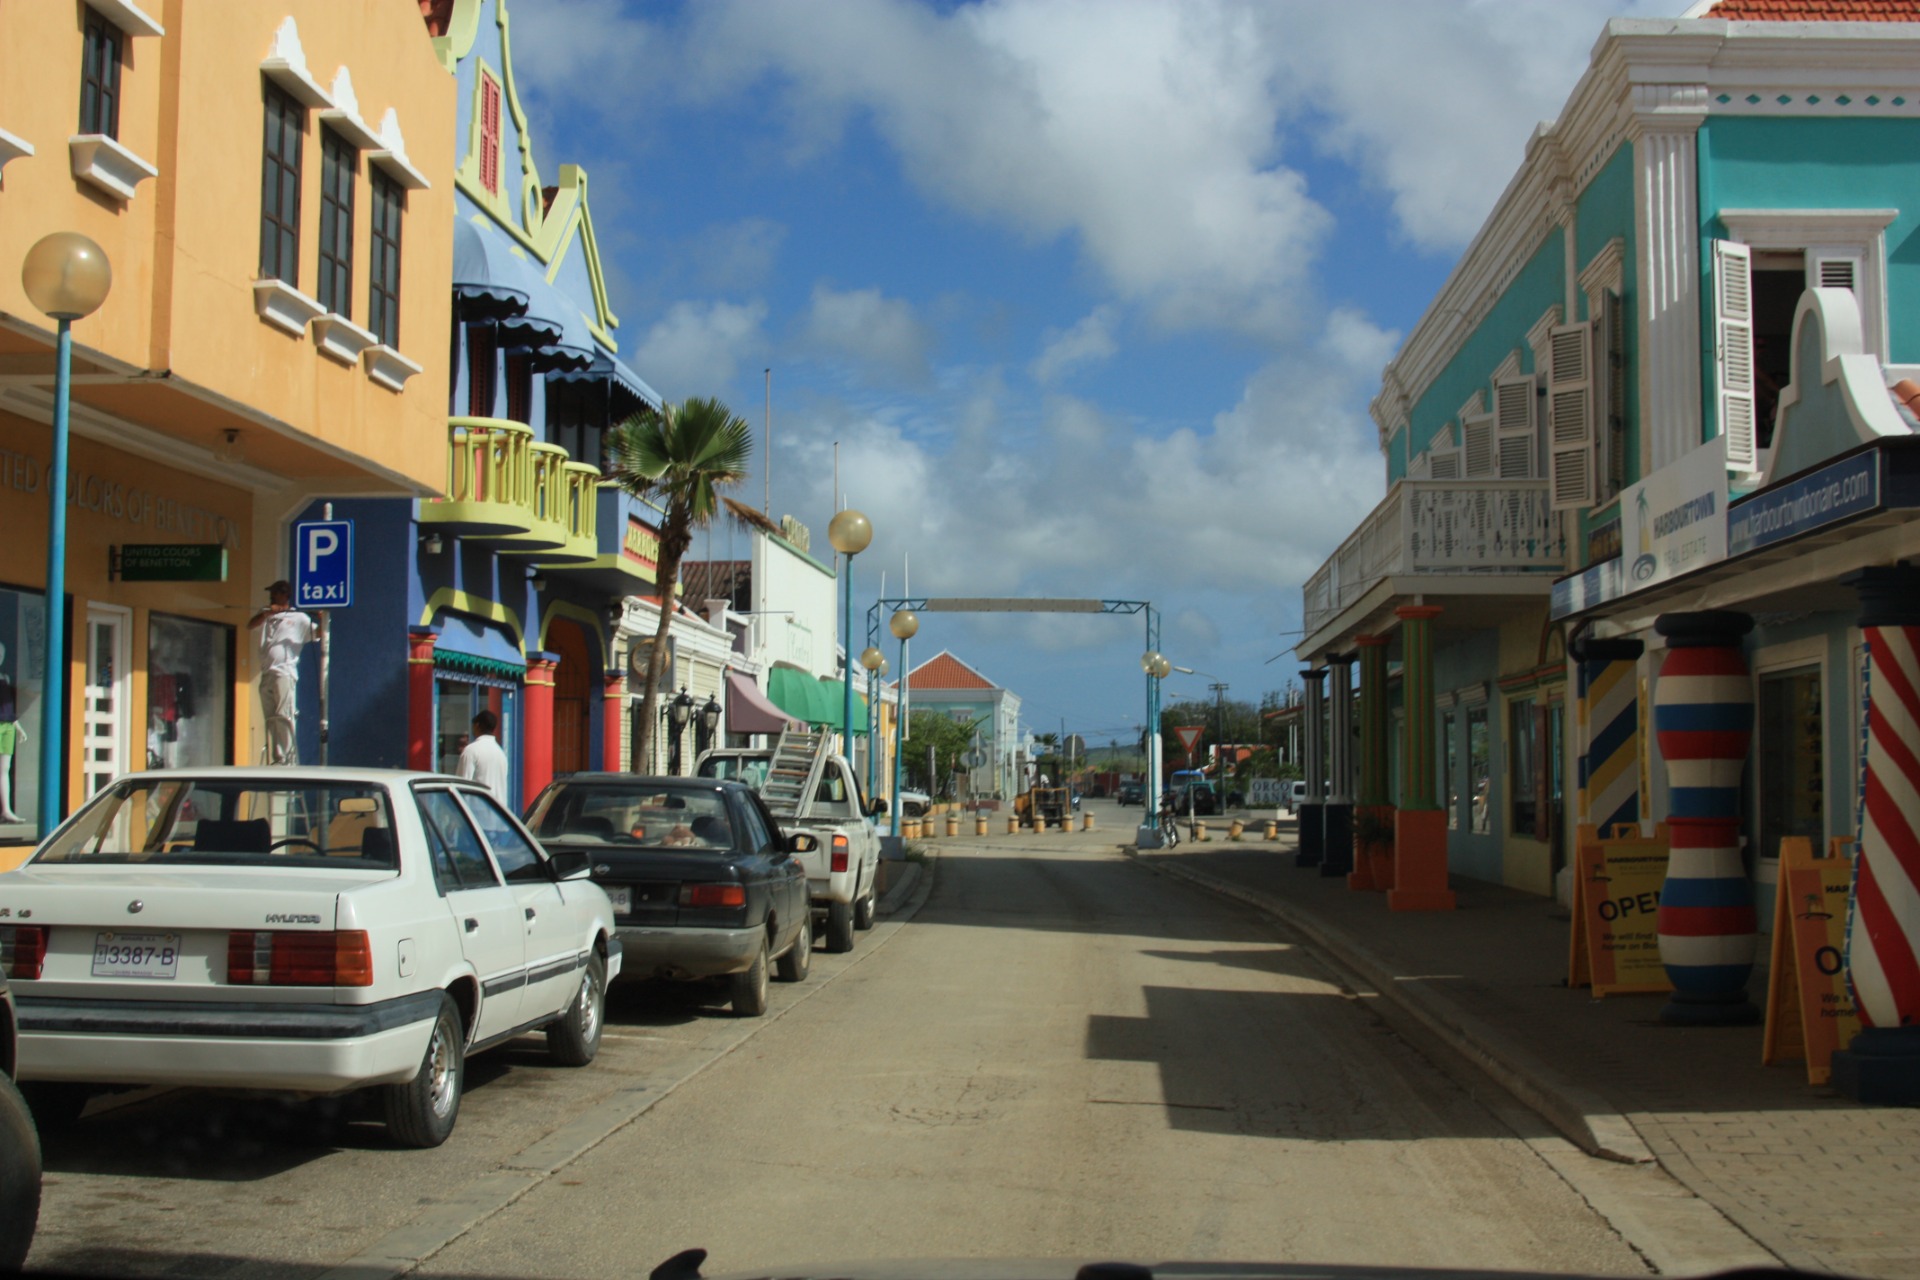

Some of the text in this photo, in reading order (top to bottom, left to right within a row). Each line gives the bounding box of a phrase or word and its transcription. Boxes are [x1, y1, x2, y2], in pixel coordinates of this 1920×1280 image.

[127, 486, 152, 525] OF
[156, 495, 241, 551] BENETTON
[124, 547, 201, 557] UNITED COLORS
[308, 528, 339, 573] P
[1681, 536, 1707, 562] ESTATE
[124, 557, 137, 567] OF
[301, 580, 345, 600] taxi
[1252, 781, 1290, 792] ORCO
[1253, 791, 1288, 802] BANK
[265, 913, 321, 924] HYUNDAI
[108, 945, 175, 966] 3387-B
[1820, 992, 1840, 1004] We
[1820, 1007, 1856, 1018] home
